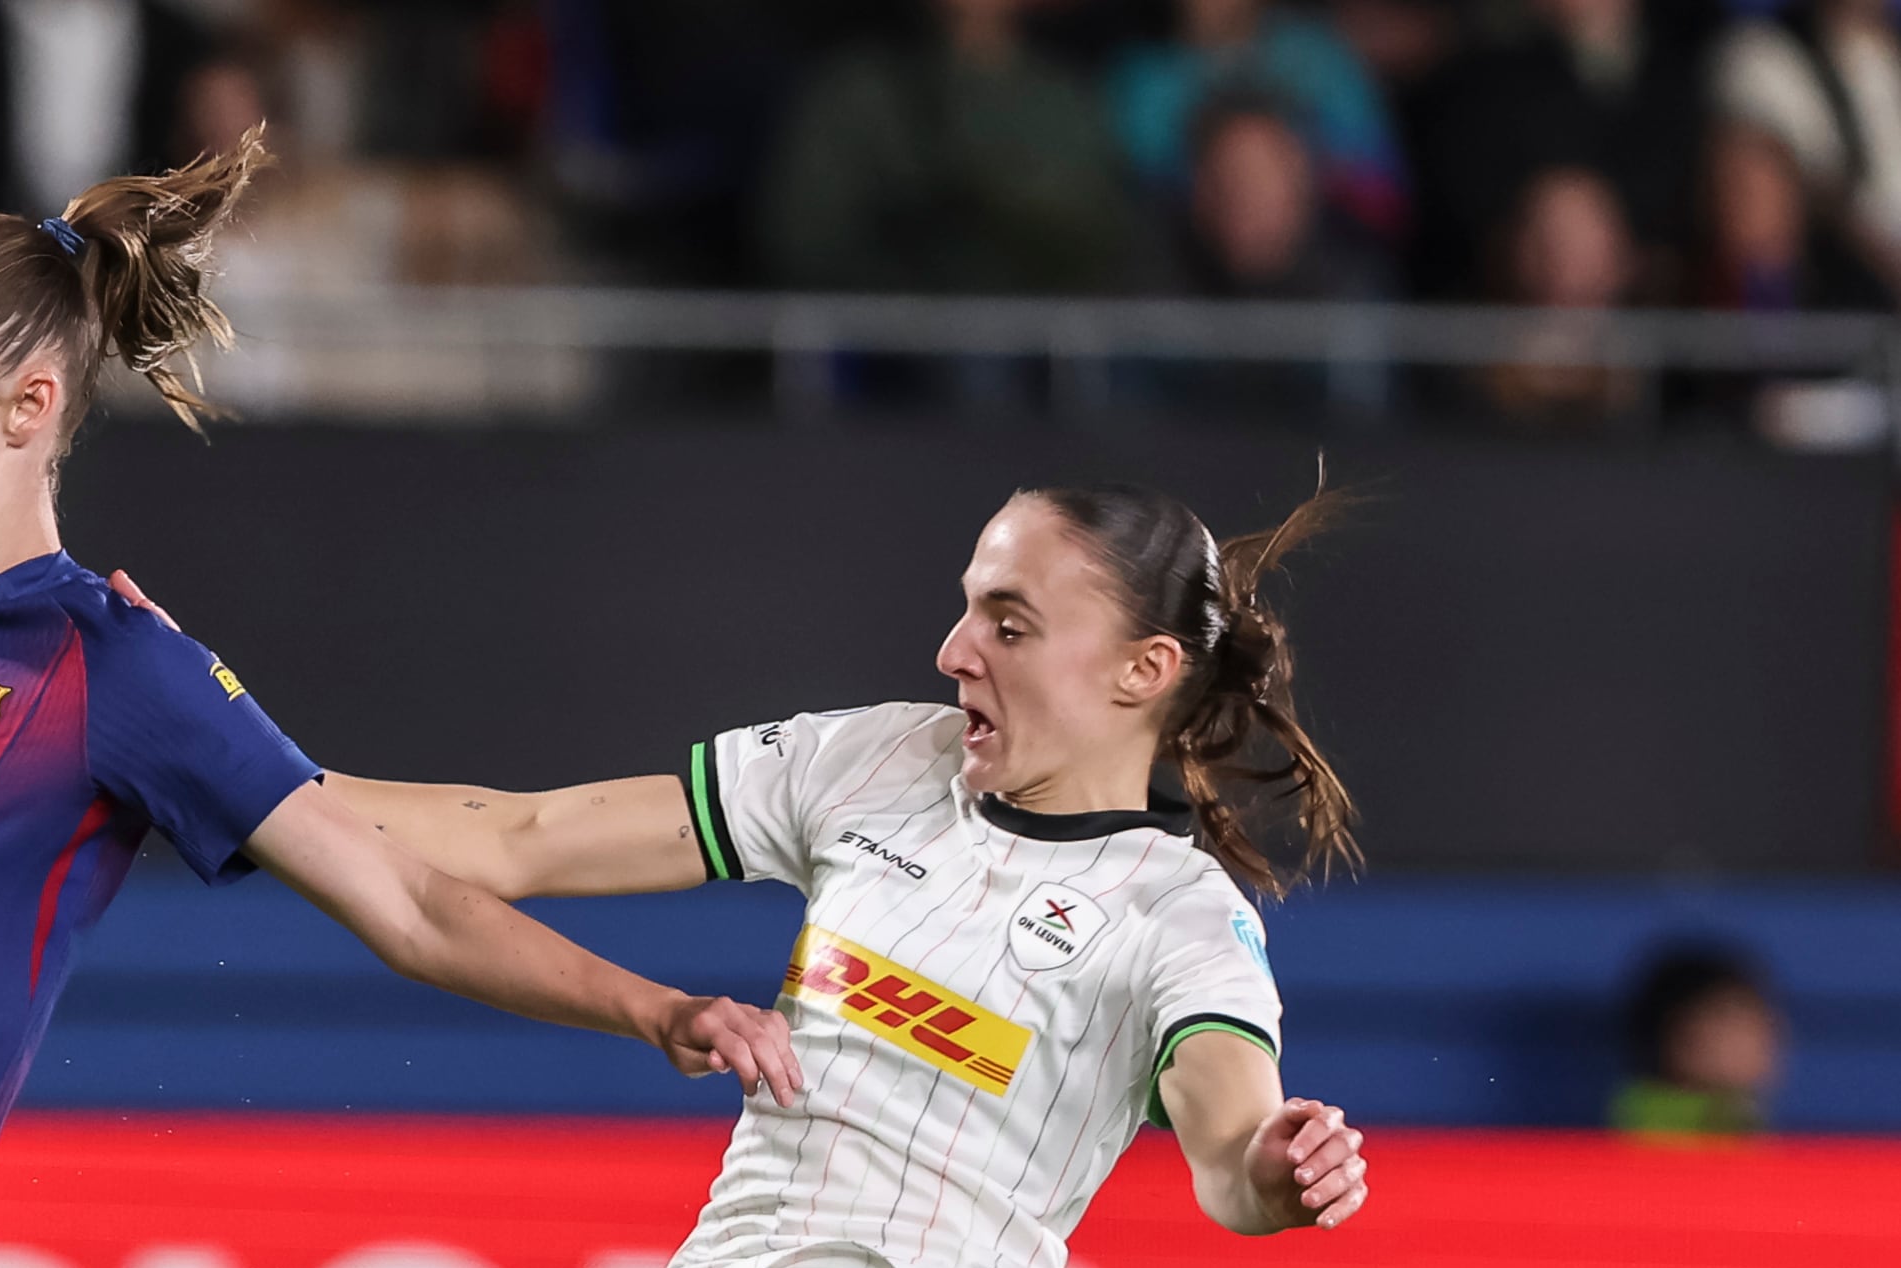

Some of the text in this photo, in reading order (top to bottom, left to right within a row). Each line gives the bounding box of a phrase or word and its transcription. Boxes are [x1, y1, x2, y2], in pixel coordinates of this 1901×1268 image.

[838, 831, 927, 880] STANNO
[1017, 916, 1075, 955] OH LEUVEN
[801, 944, 977, 1062] DHL
